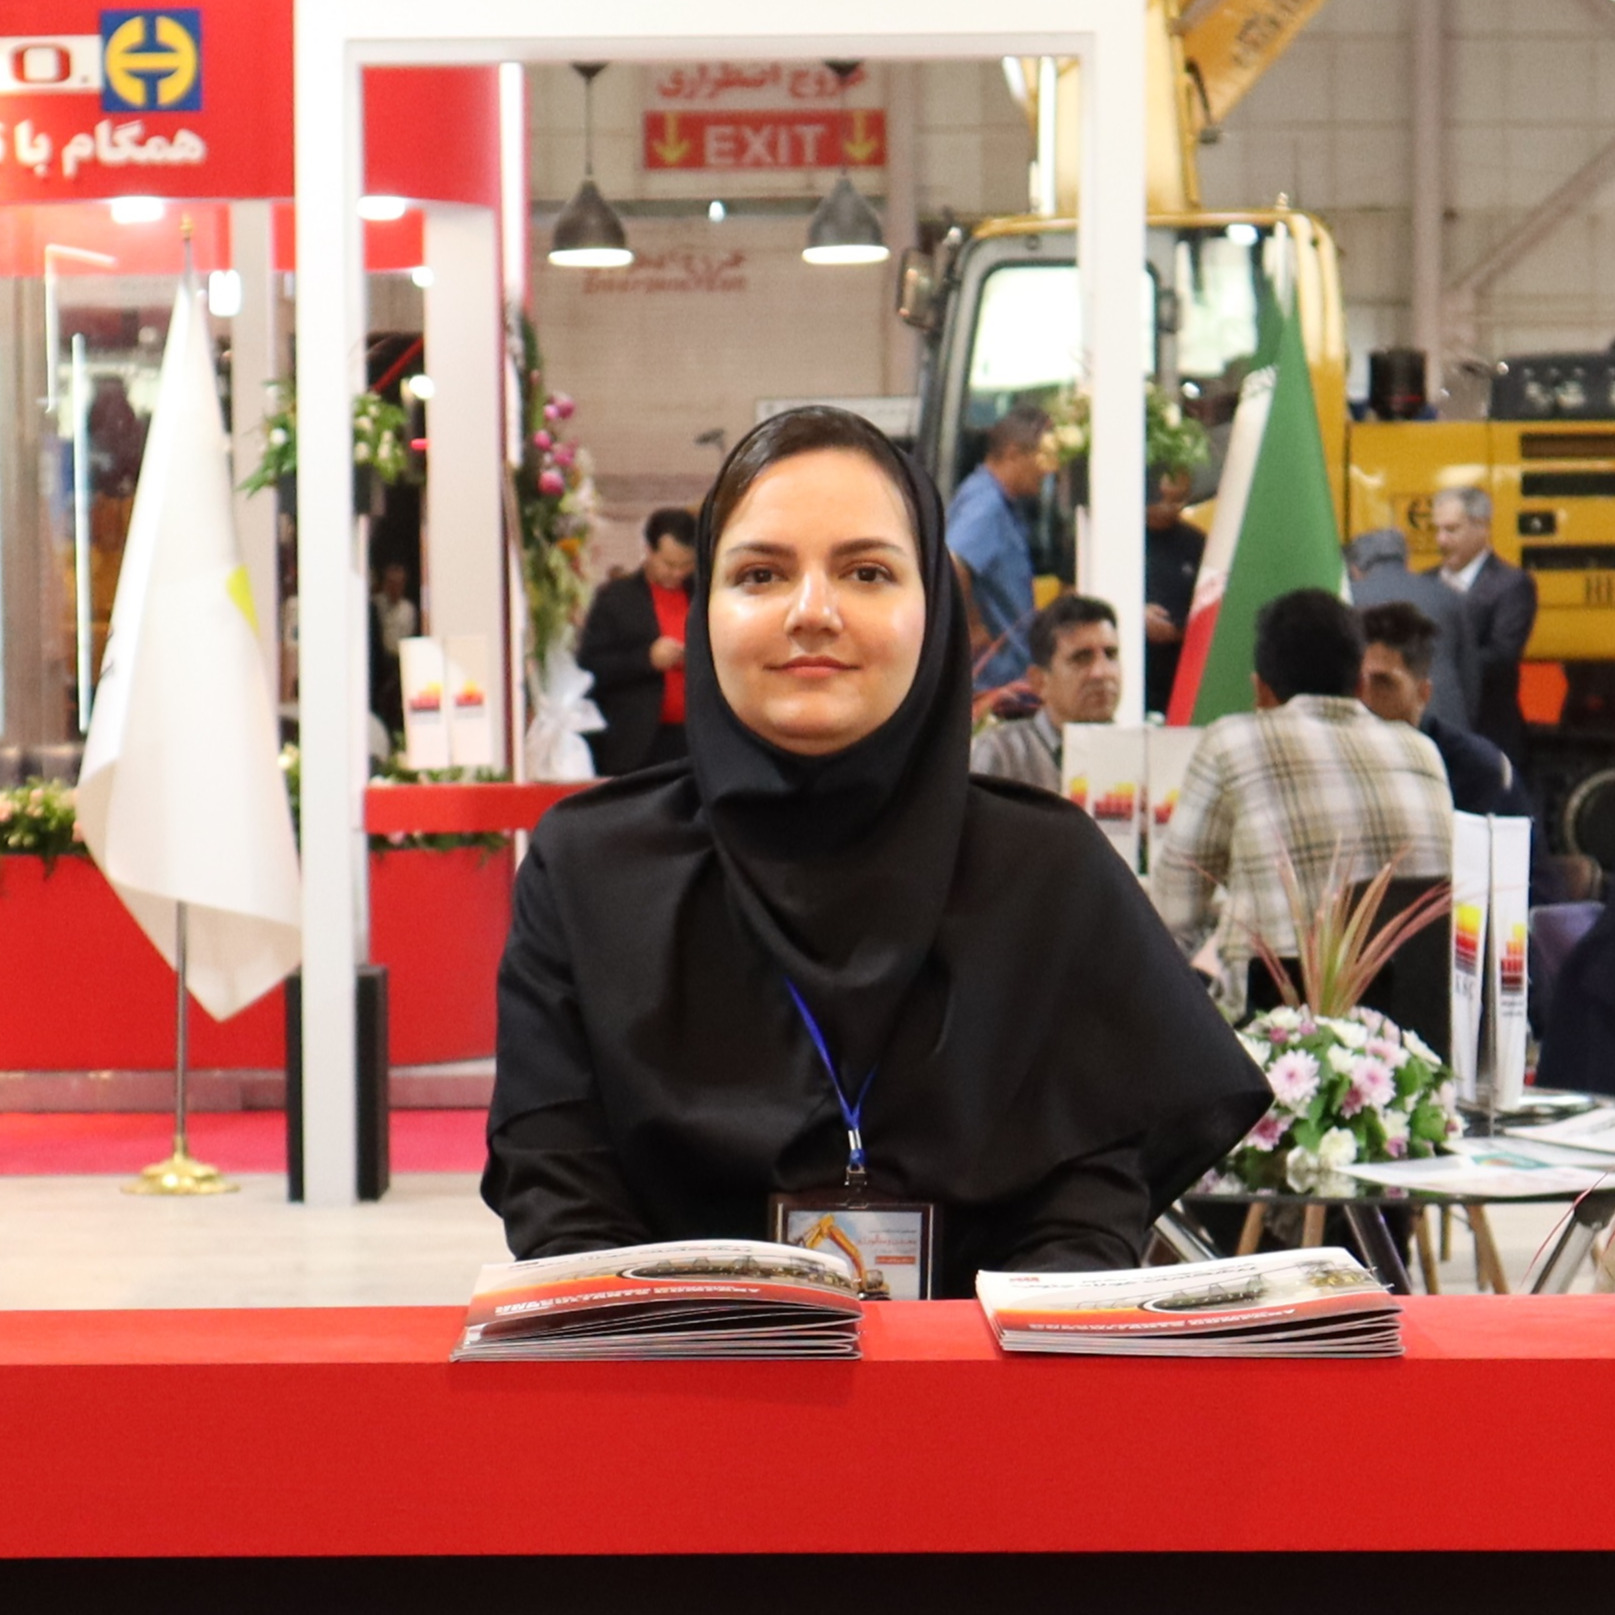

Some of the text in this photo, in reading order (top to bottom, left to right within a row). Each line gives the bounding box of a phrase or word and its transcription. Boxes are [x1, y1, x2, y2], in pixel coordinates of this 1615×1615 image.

[14, 118, 52, 177] با
[61, 118, 208, 179] همگام
[704, 123, 827, 166] EXIT
